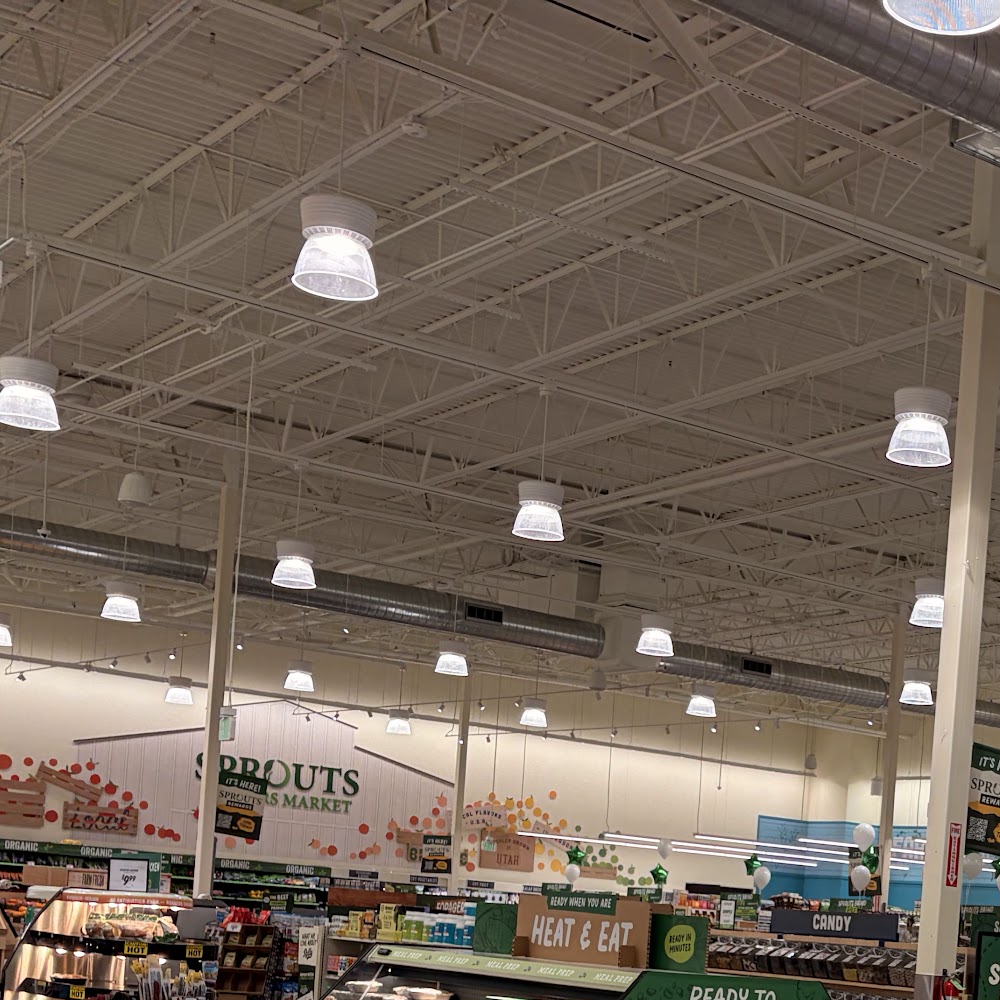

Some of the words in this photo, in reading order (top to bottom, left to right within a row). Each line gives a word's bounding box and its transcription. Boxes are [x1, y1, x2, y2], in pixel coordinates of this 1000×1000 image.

[979, 756, 996, 769] IT'S
[240, 780, 261, 793] HERE!
[219, 790, 262, 806] SPROUTS
[283, 793, 352, 813] MARKET
[5, 840, 39, 851] ORGANIC
[81, 847, 113, 858] ORGANIC
[221, 859, 250, 871] ORGANIC
[496, 854, 520, 866] UTAH
[286, 865, 314, 877] ORGANIC
[550, 896, 568, 907] READY
[568, 897, 586, 909] WHEN
[587, 897, 599, 909] YOU
[600, 899, 612, 910] ARE
[813, 913, 852, 932] CANDY
[531, 915, 576, 949] HEAT
[580, 920, 592, 951] &
[597, 921, 634, 953] EAT
[669, 934, 684, 943] READY
[686, 933, 692, 942] IN
[127, 945, 146, 954] HOT
[187, 949, 202, 957] HOT
[669, 943, 691, 953] MINUTES
[437, 955, 454, 963] MEAL
[453, 957, 469, 965] PREP
[486, 961, 503, 969] MEAL
[502, 962, 520, 971] PREP
[538, 967, 556, 976] MEAL
[556, 968, 575, 978] PREP
[594, 973, 613, 982] MEAL
[613, 975, 634, 986] PREP
